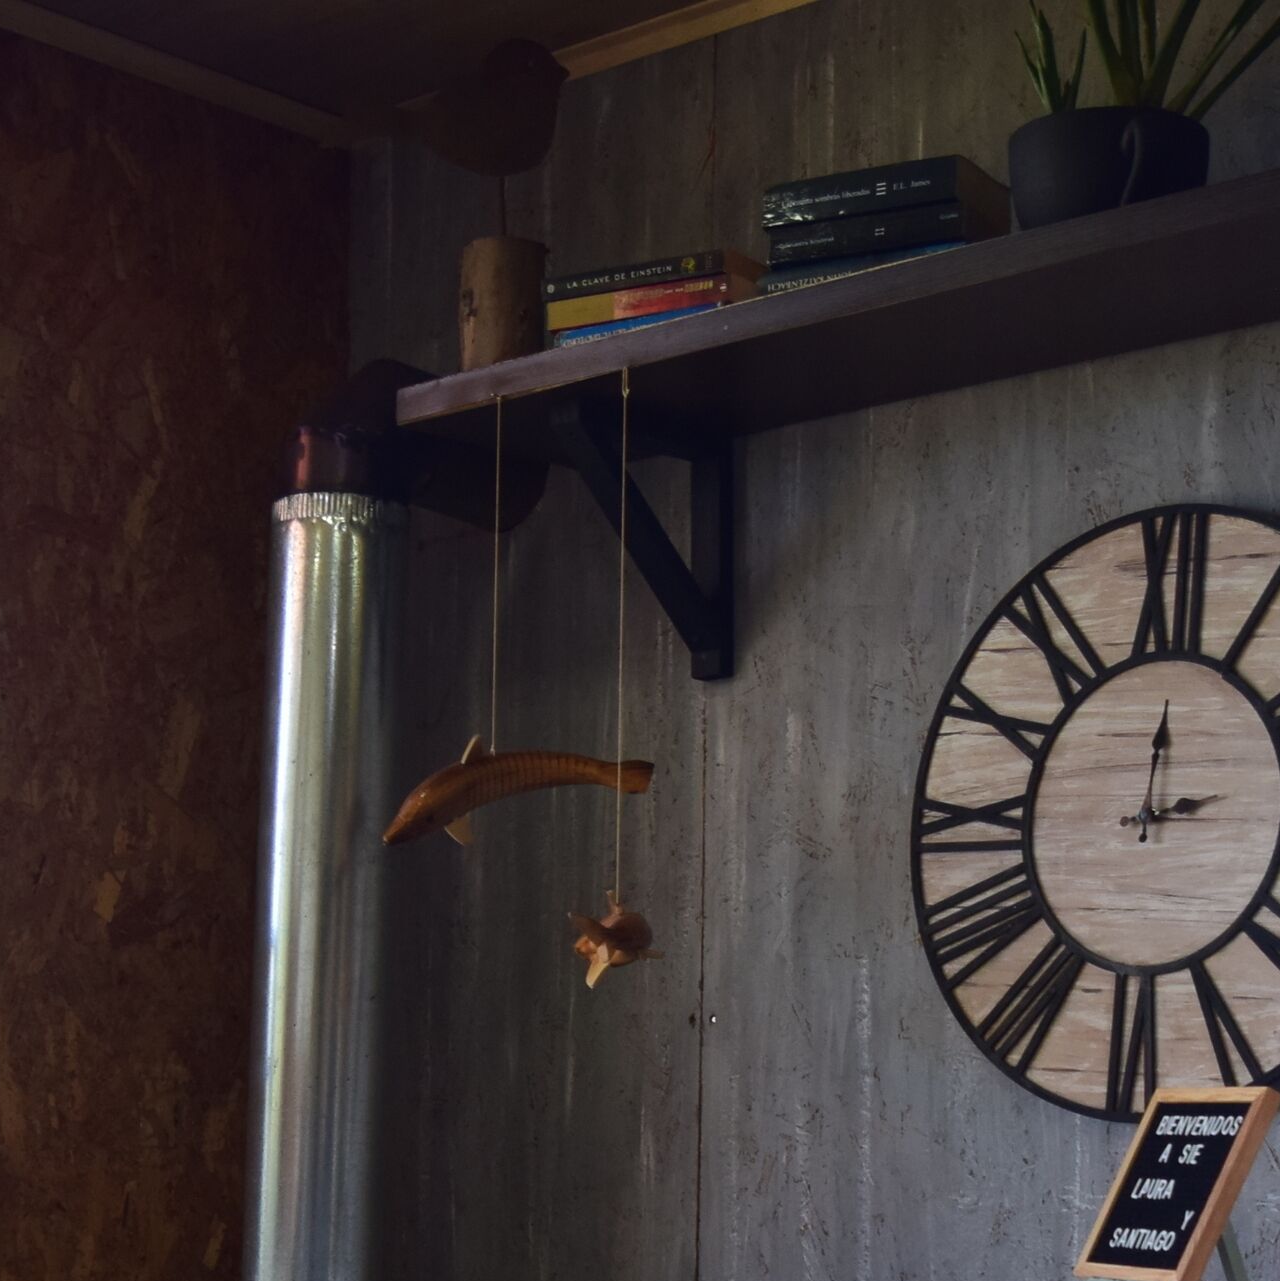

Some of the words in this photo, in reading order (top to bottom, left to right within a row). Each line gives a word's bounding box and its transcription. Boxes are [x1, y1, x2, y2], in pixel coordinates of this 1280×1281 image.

[566, 281, 578, 290] LA
[582, 275, 611, 288] CLAVE
[614, 272, 626, 282] DE
[631, 265, 673, 279] EINSTEIN
[1156, 1116, 1243, 1136] BIENVENIDOS
[1158, 1143, 1172, 1164] A
[1131, 1178, 1175, 1200] LAURA
[1181, 1210, 1194, 1231] Y
[1109, 1227, 1176, 1252] SANTIAGO
